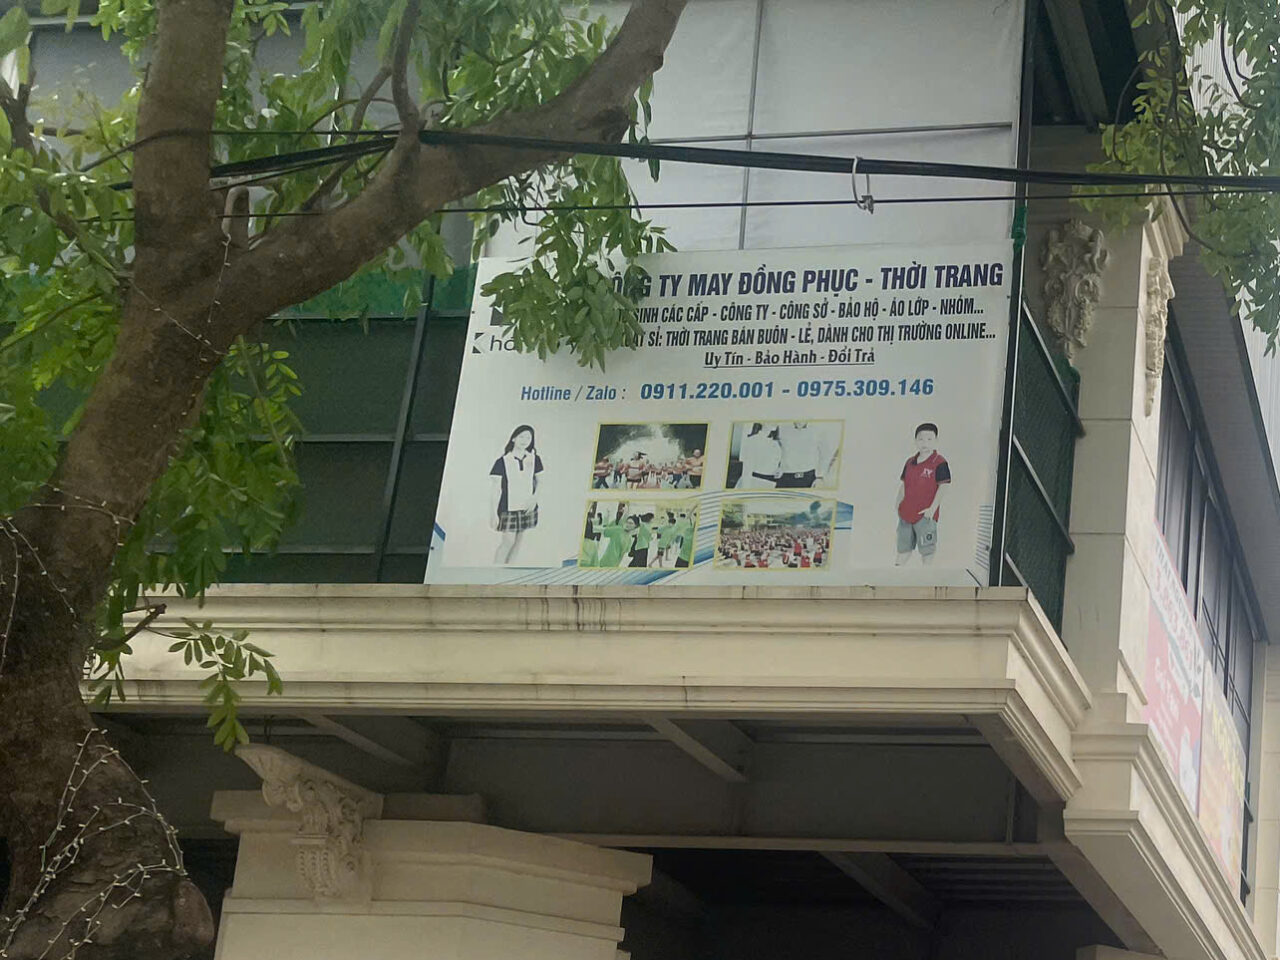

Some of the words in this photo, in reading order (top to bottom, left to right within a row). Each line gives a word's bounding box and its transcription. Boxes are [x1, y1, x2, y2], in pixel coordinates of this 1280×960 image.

[659, 274, 683, 297] TY
[687, 273, 733, 296] MAY
[738, 264, 796, 295] ĐỒNG
[802, 268, 859, 297] PHỤC
[880, 260, 927, 290] THỜI
[934, 262, 1004, 289] TRANG
[661, 303, 684, 323] CÁC
[686, 301, 709, 322] CẤP
[720, 302, 752, 321] CÔNG
[756, 304, 769, 321] TY
[779, 300, 810, 320] CÔNG
[812, 297, 829, 319] SỞ
[838, 296, 861, 318] BẢO
[863, 297, 879, 321] HỘ
[889, 297, 905, 317] ÁO
[907, 296, 929, 316] LỚP
[940, 295, 984, 315] NHÓM...
[648, 325, 663, 347] SỈ:
[666, 326, 690, 347] THỜI
[693, 329, 729, 346] TRANG
[731, 326, 755, 345] BÁN
[757, 325, 788, 345] BUÔN
[798, 322, 814, 345] LẺ,
[817, 323, 849, 343] DÀNH
[851, 325, 874, 342] CHO
[877, 325, 895, 345] THỊ
[898, 320, 942, 341] TRƯỜNG
[945, 322, 996, 340] ONLINE...
[704, 352, 721, 369] Uy
[724, 351, 744, 365] Tín
[755, 349, 780, 364] Bảo
[783, 350, 817, 364] Hành
[828, 345, 852, 362] Đổi
[854, 346, 875, 362] Trả
[520, 385, 571, 400] Hotline
[585, 385, 617, 400] Zalo
[640, 381, 774, 400] 0911.220.001
[797, 378, 934, 397] 0975.309.146
